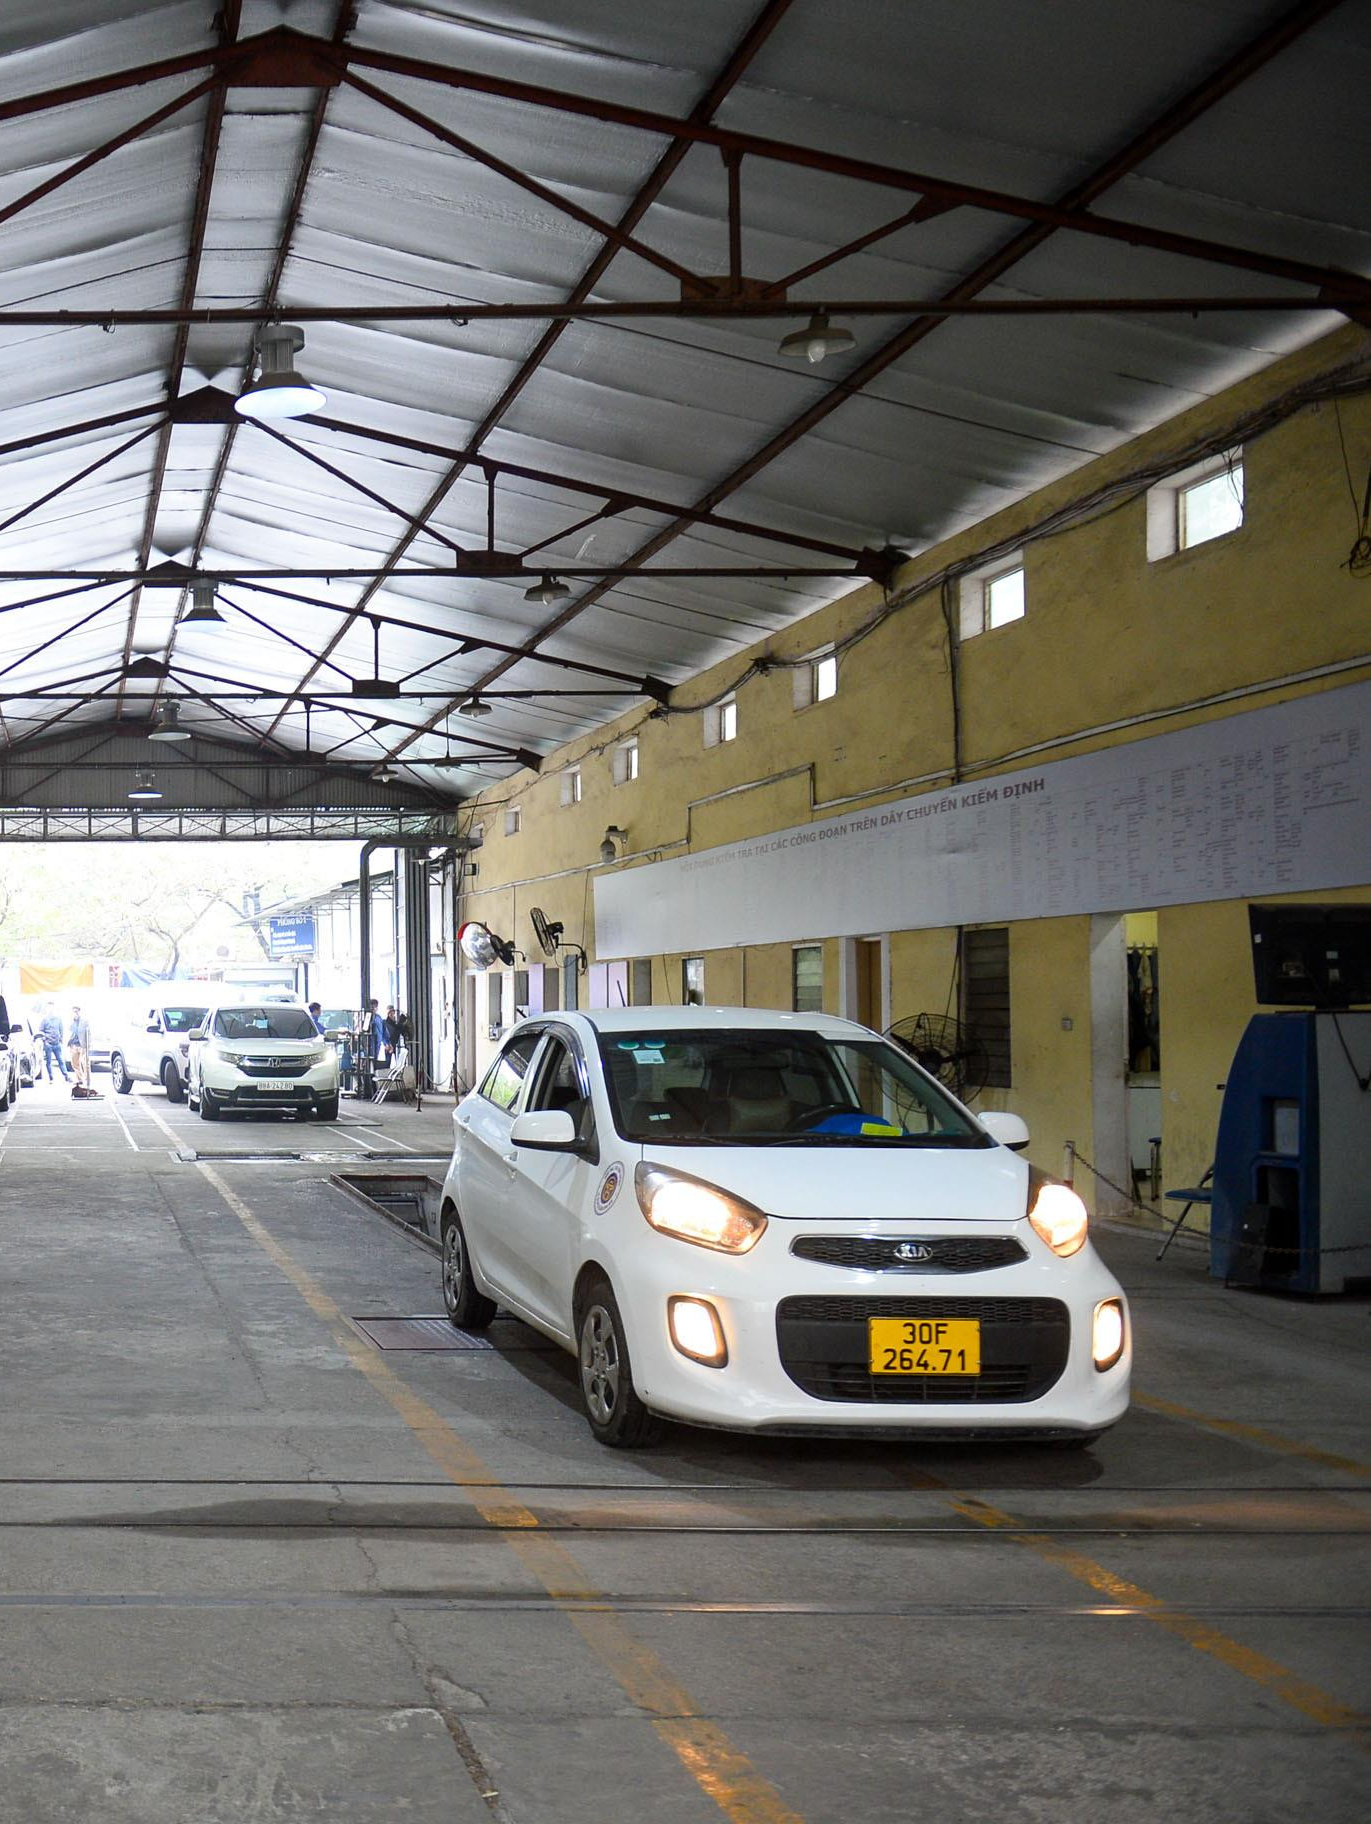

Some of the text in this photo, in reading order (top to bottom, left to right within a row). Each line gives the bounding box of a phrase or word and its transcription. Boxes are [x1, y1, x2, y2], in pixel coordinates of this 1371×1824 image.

[790, 831, 816, 848] CÔNG
[819, 824, 847, 840] ĐOẠN
[850, 815, 877, 832] TRÊN
[880, 809, 903, 826] DÂY
[906, 797, 957, 820] CHUYỀN
[961, 787, 998, 808] KIỂM
[1003, 778, 1045, 800] ĐỊNH
[900, 1243, 929, 1258] KIA
[902, 1322, 949, 1345] 30F
[883, 1348, 966, 1371] 264.71
